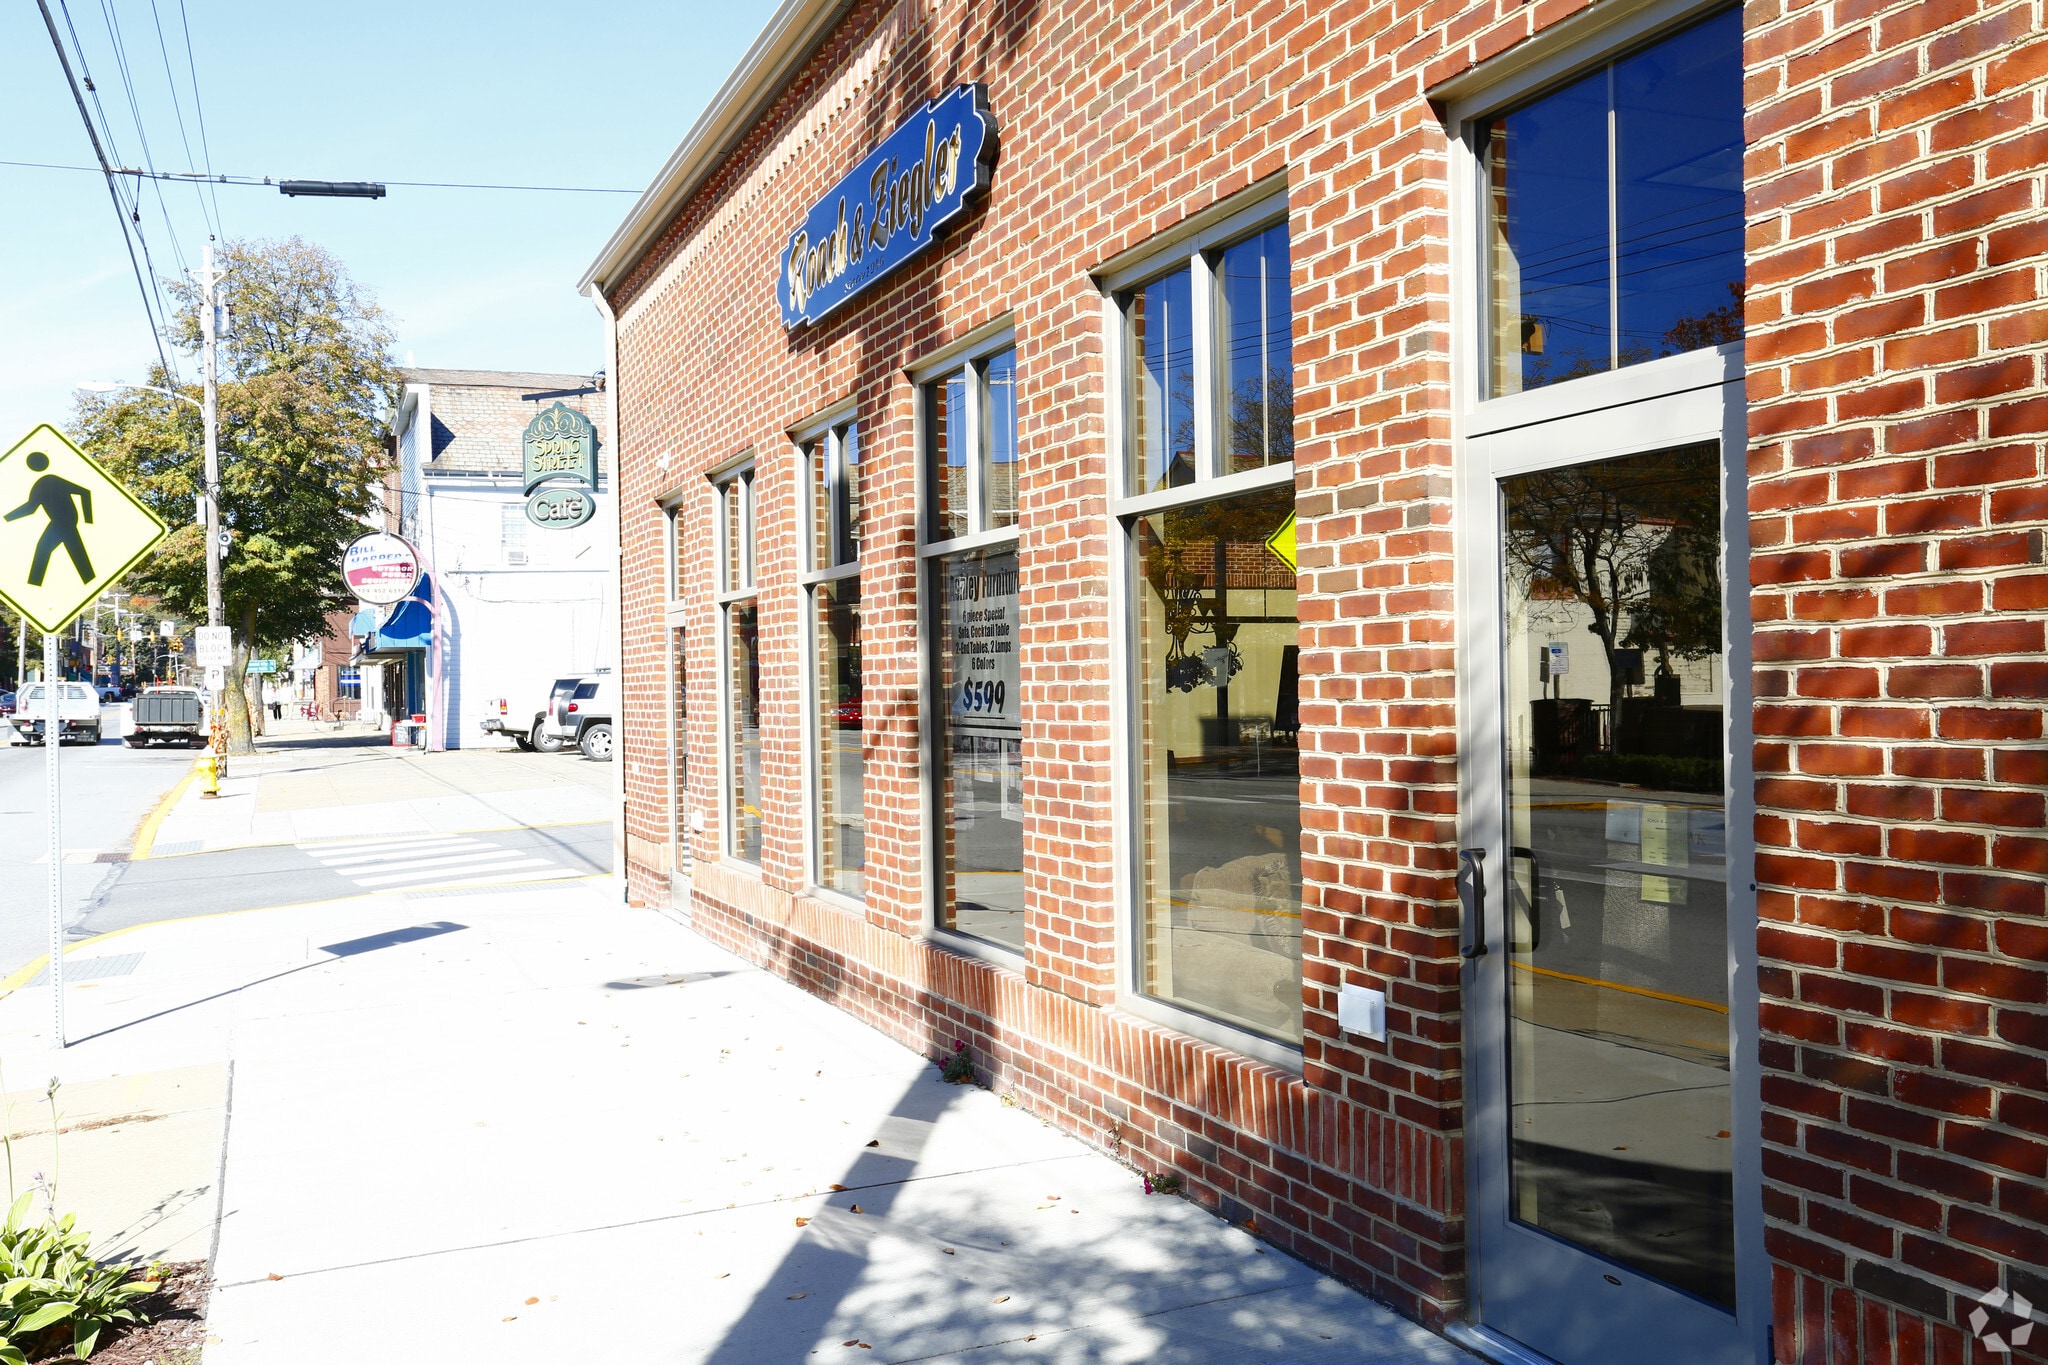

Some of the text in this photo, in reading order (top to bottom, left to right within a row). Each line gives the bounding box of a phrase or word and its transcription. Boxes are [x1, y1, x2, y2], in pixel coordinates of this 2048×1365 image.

[788, 118, 961, 314] Roach & Ziegler
[532, 440, 580, 456] SPRING
[530, 455, 583, 472] STREET
[534, 496, 583, 521] Café
[350, 546, 375, 556] BILL
[962, 606, 1005, 624] 6 piece Special
[198, 631, 228, 641] DO NOT
[971, 624, 995, 638] Cocktail
[995, 622, 1010, 637] Table
[199, 644, 229, 653] BLOCK
[970, 641, 989, 655] Tables,
[990, 640, 995, 653] 2
[995, 640, 1011, 653] Lamps
[971, 656, 995, 670] 6 Colors
[963, 677, 1005, 713] $599
